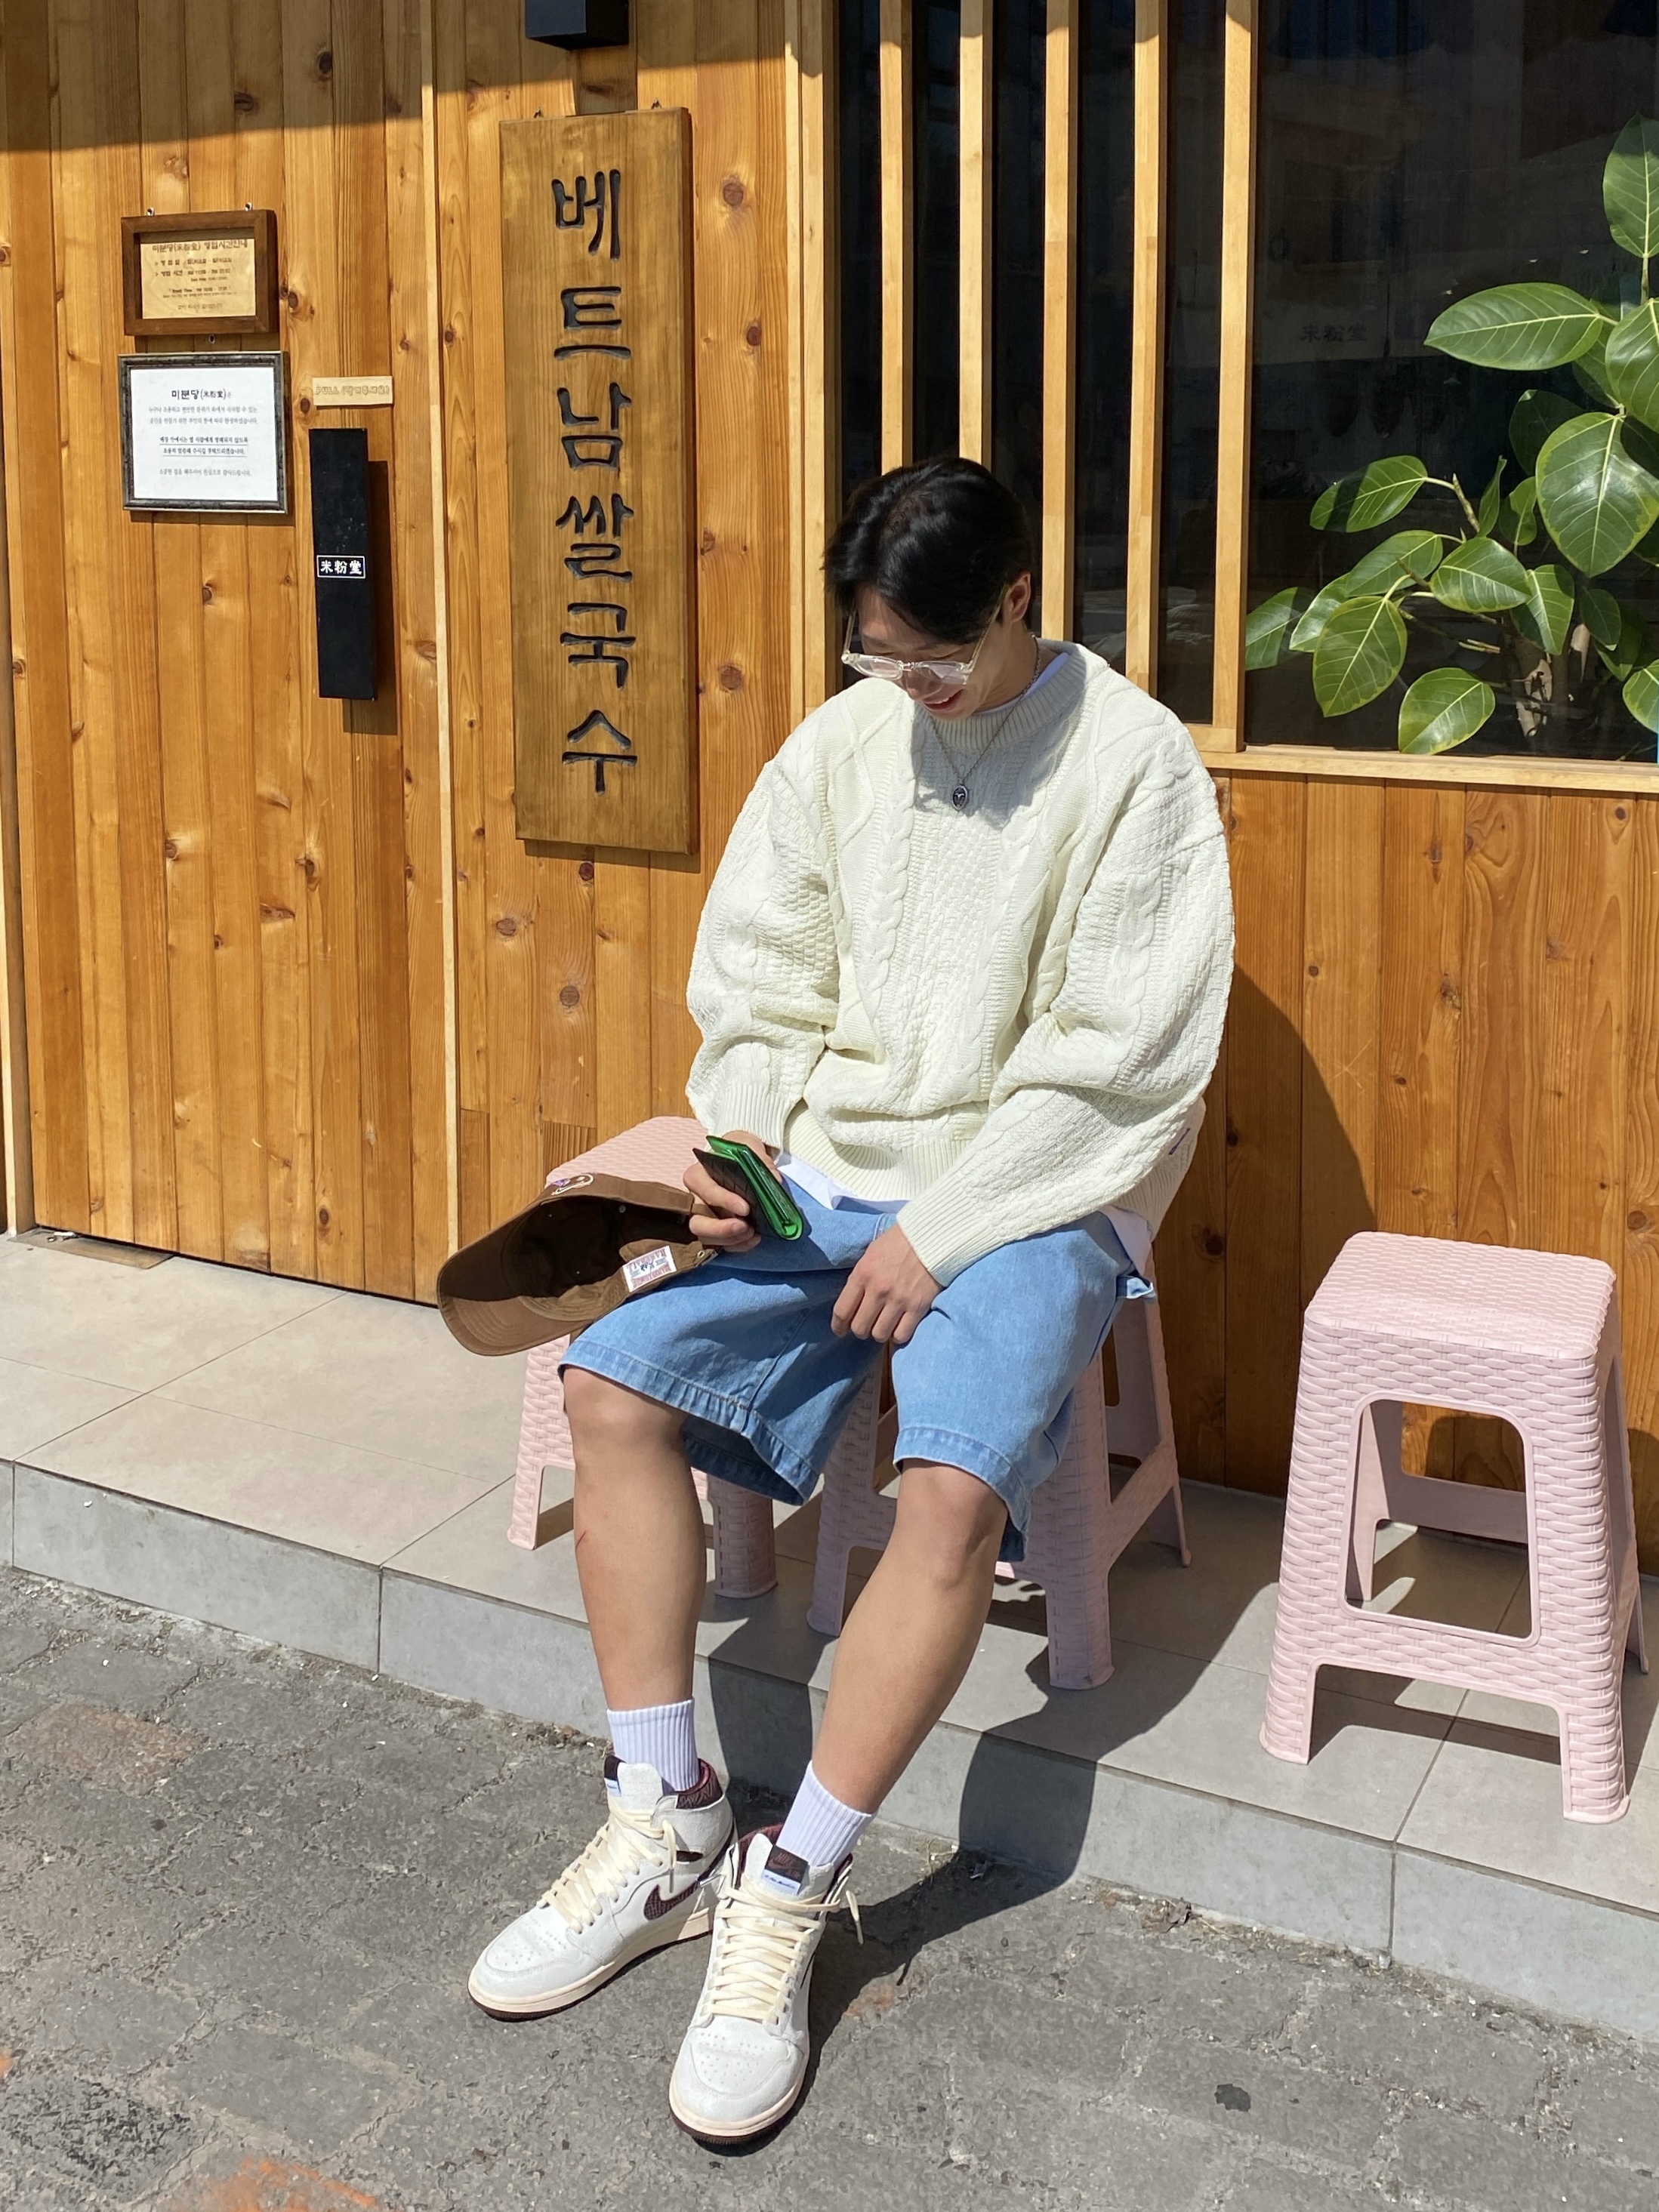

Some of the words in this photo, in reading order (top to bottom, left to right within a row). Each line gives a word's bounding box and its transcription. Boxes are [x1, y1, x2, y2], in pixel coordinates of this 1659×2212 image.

[316, 386, 340, 395] PULL
[551, 168, 637, 795] 베트남쌀국수
[320, 559, 362, 575] 米粉堂
